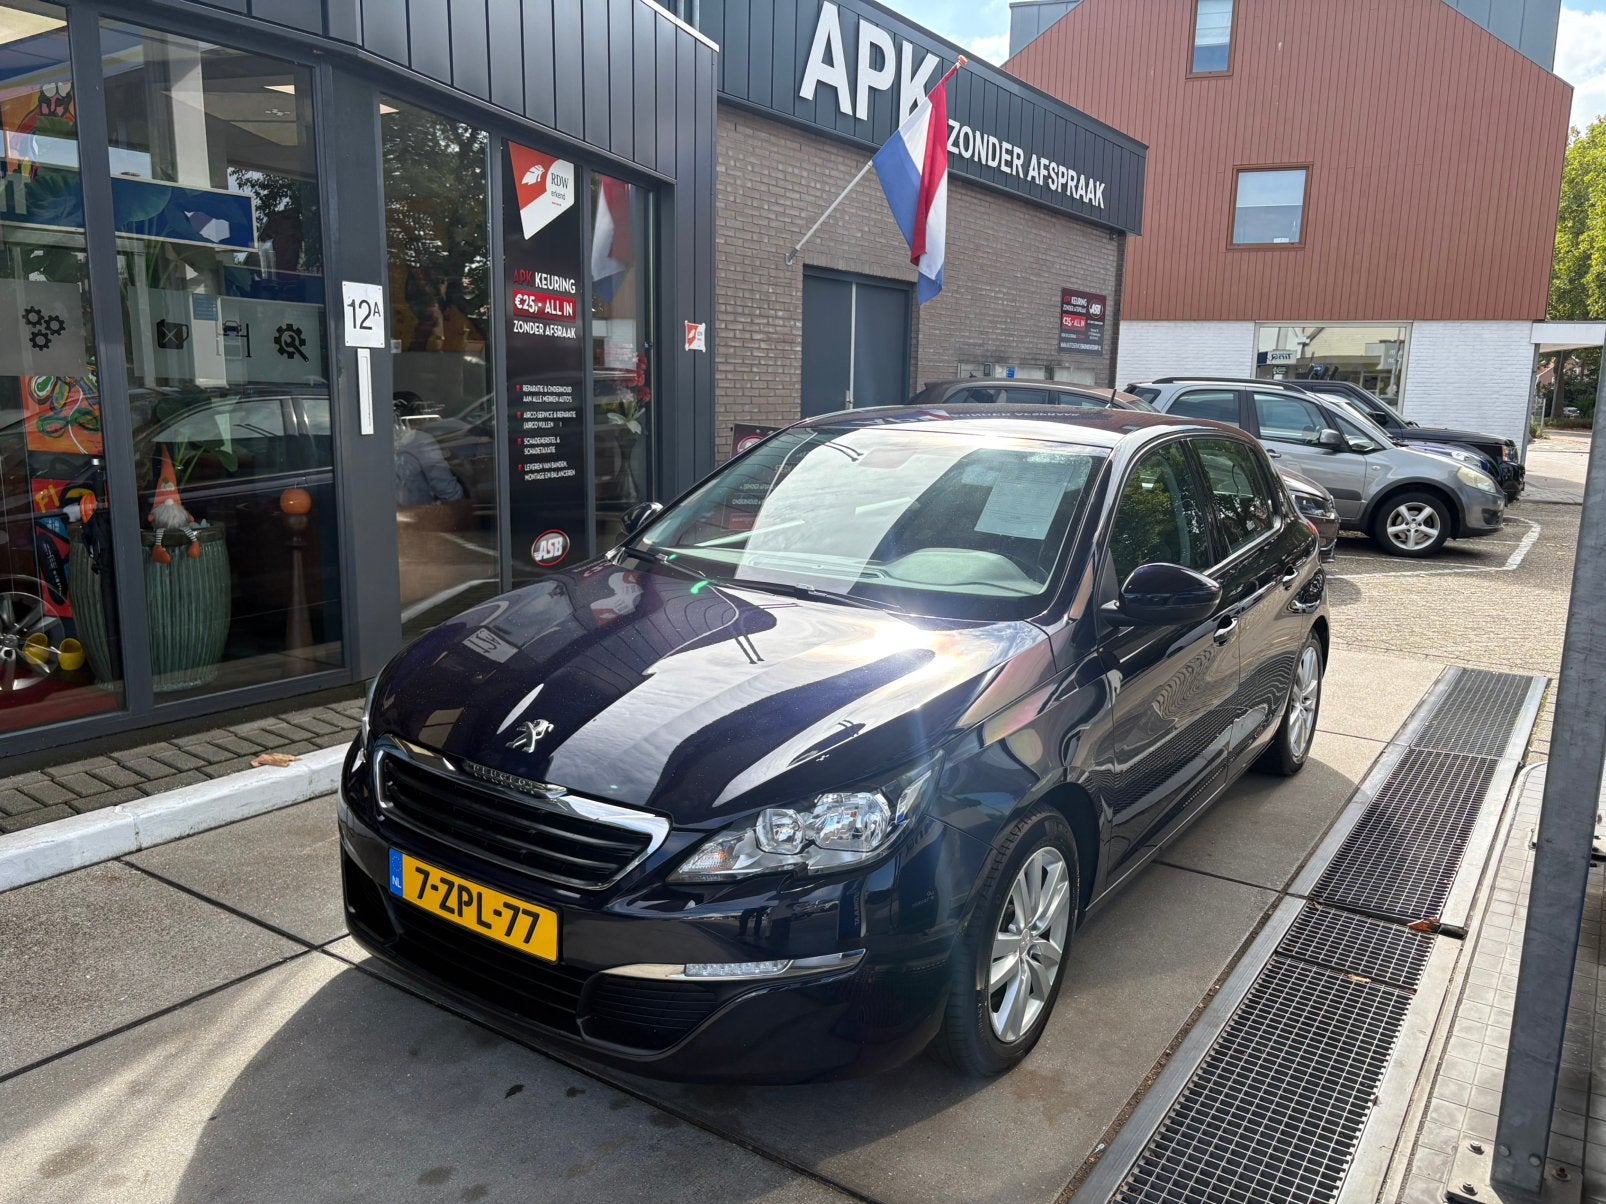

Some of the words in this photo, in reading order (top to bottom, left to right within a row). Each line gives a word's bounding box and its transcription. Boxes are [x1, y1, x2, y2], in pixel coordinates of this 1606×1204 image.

[799, 0, 940, 131] APK
[946, 118, 1024, 179] ZONDER
[1026, 153, 1106, 209] AFSPRAAK
[550, 172, 569, 190] RDW
[513, 268, 533, 287] APK
[535, 271, 576, 294] KEURING
[346, 298, 381, 331] 12A
[515, 293, 543, 314] €25,-
[544, 298, 563, 316] ALL
[563, 302, 573, 317] IN
[513, 320, 544, 336] ZONDER
[544, 324, 577, 339] AFSRAAK
[534, 536, 564, 561] ASB
[391, 875, 402, 889] NL
[415, 866, 540, 945] 7-ZPL-77
